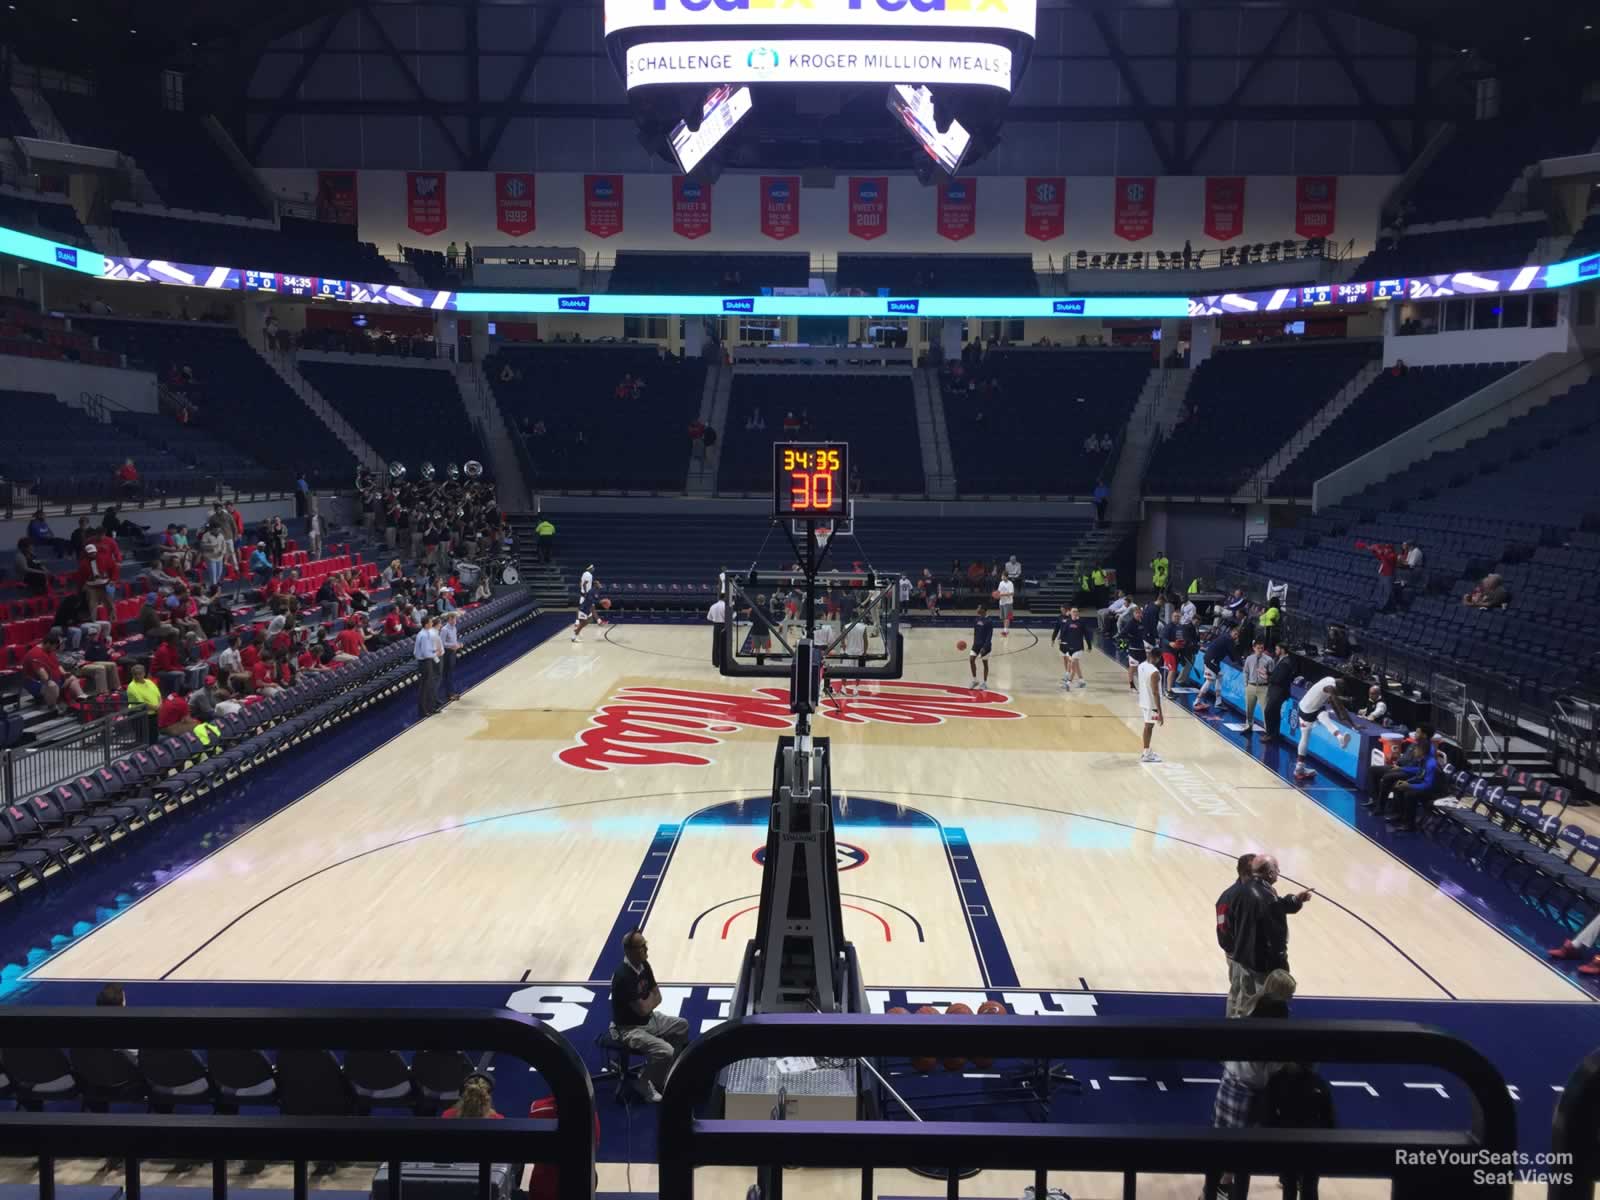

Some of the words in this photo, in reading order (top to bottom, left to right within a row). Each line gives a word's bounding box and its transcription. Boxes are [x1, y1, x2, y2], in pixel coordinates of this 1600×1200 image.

[637, 55, 733, 72] CHALLENGE
[789, 55, 858, 69] KROGER
[864, 55, 943, 69] MILLLION
[949, 56, 1001, 73] MEALS
[857, 213, 880, 226] 2001
[263, 279, 271, 288] 0
[283, 276, 312, 288] 34:35
[323, 285, 330, 294] 0
[1338, 284, 1368, 296] 34:35
[1379, 286, 1386, 297] 0
[1319, 292, 1326, 301] 0
[561, 300, 587, 308] StubHub
[725, 301, 751, 309] StubHub
[890, 302, 916, 310] StubHub
[1055, 303, 1081, 311] StubHub
[784, 450, 840, 471] 34:35
[792, 473, 832, 509] 30
